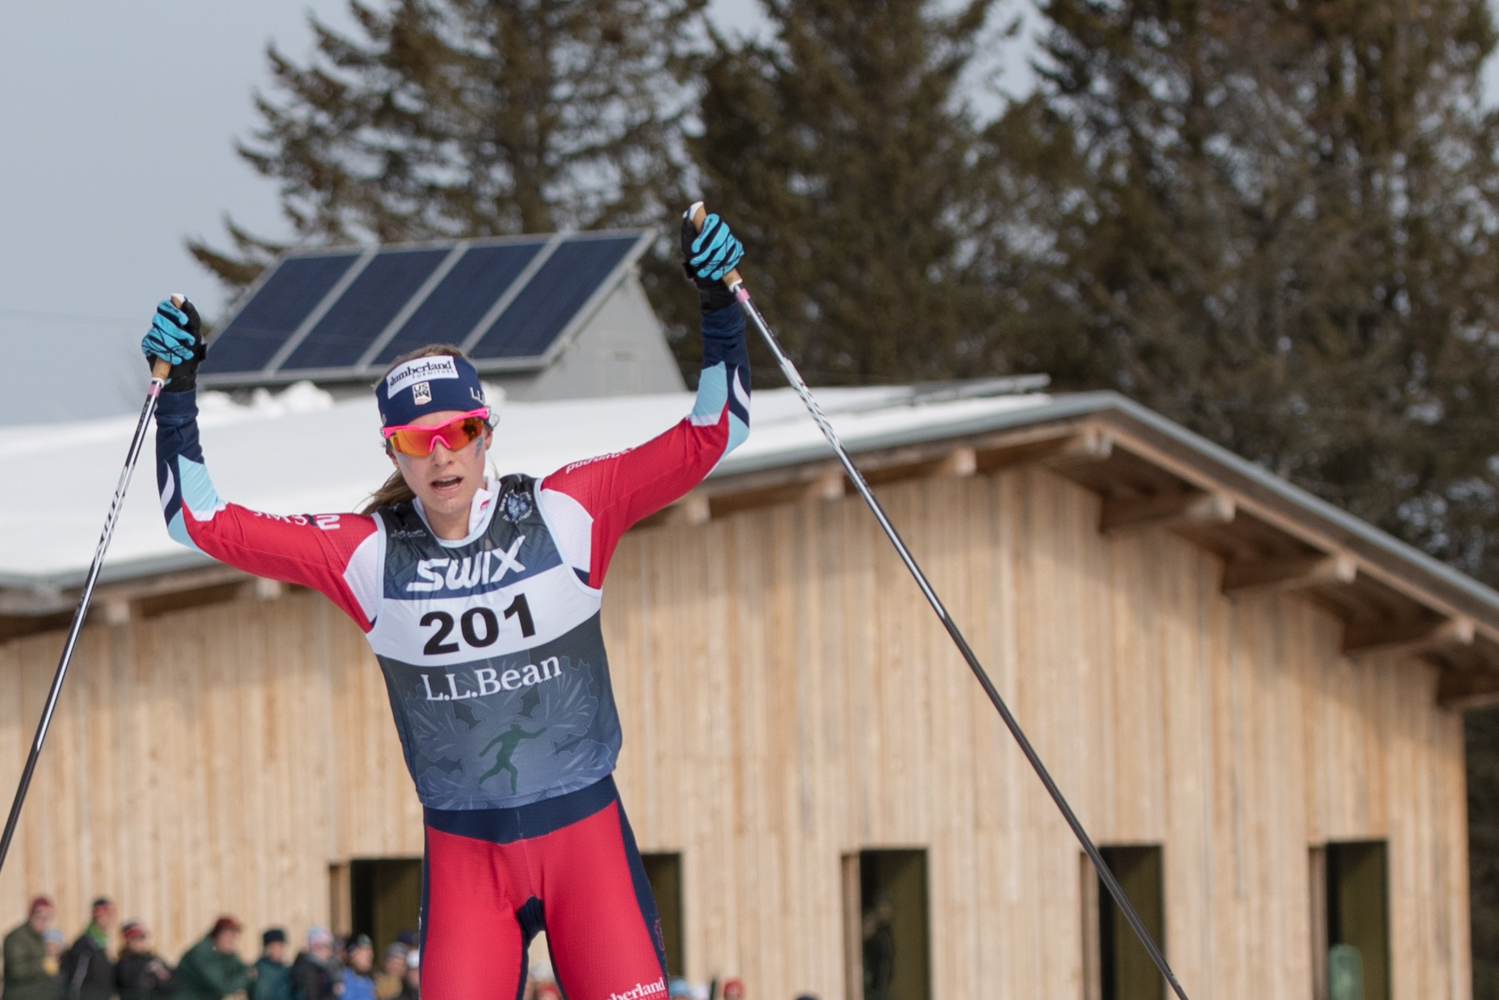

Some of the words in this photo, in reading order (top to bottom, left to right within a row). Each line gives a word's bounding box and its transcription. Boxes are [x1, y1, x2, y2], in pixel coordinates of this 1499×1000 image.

[406, 535, 526, 592] SWIX
[419, 593, 536, 656] 201
[420, 655, 562, 701] L.L.Bean
